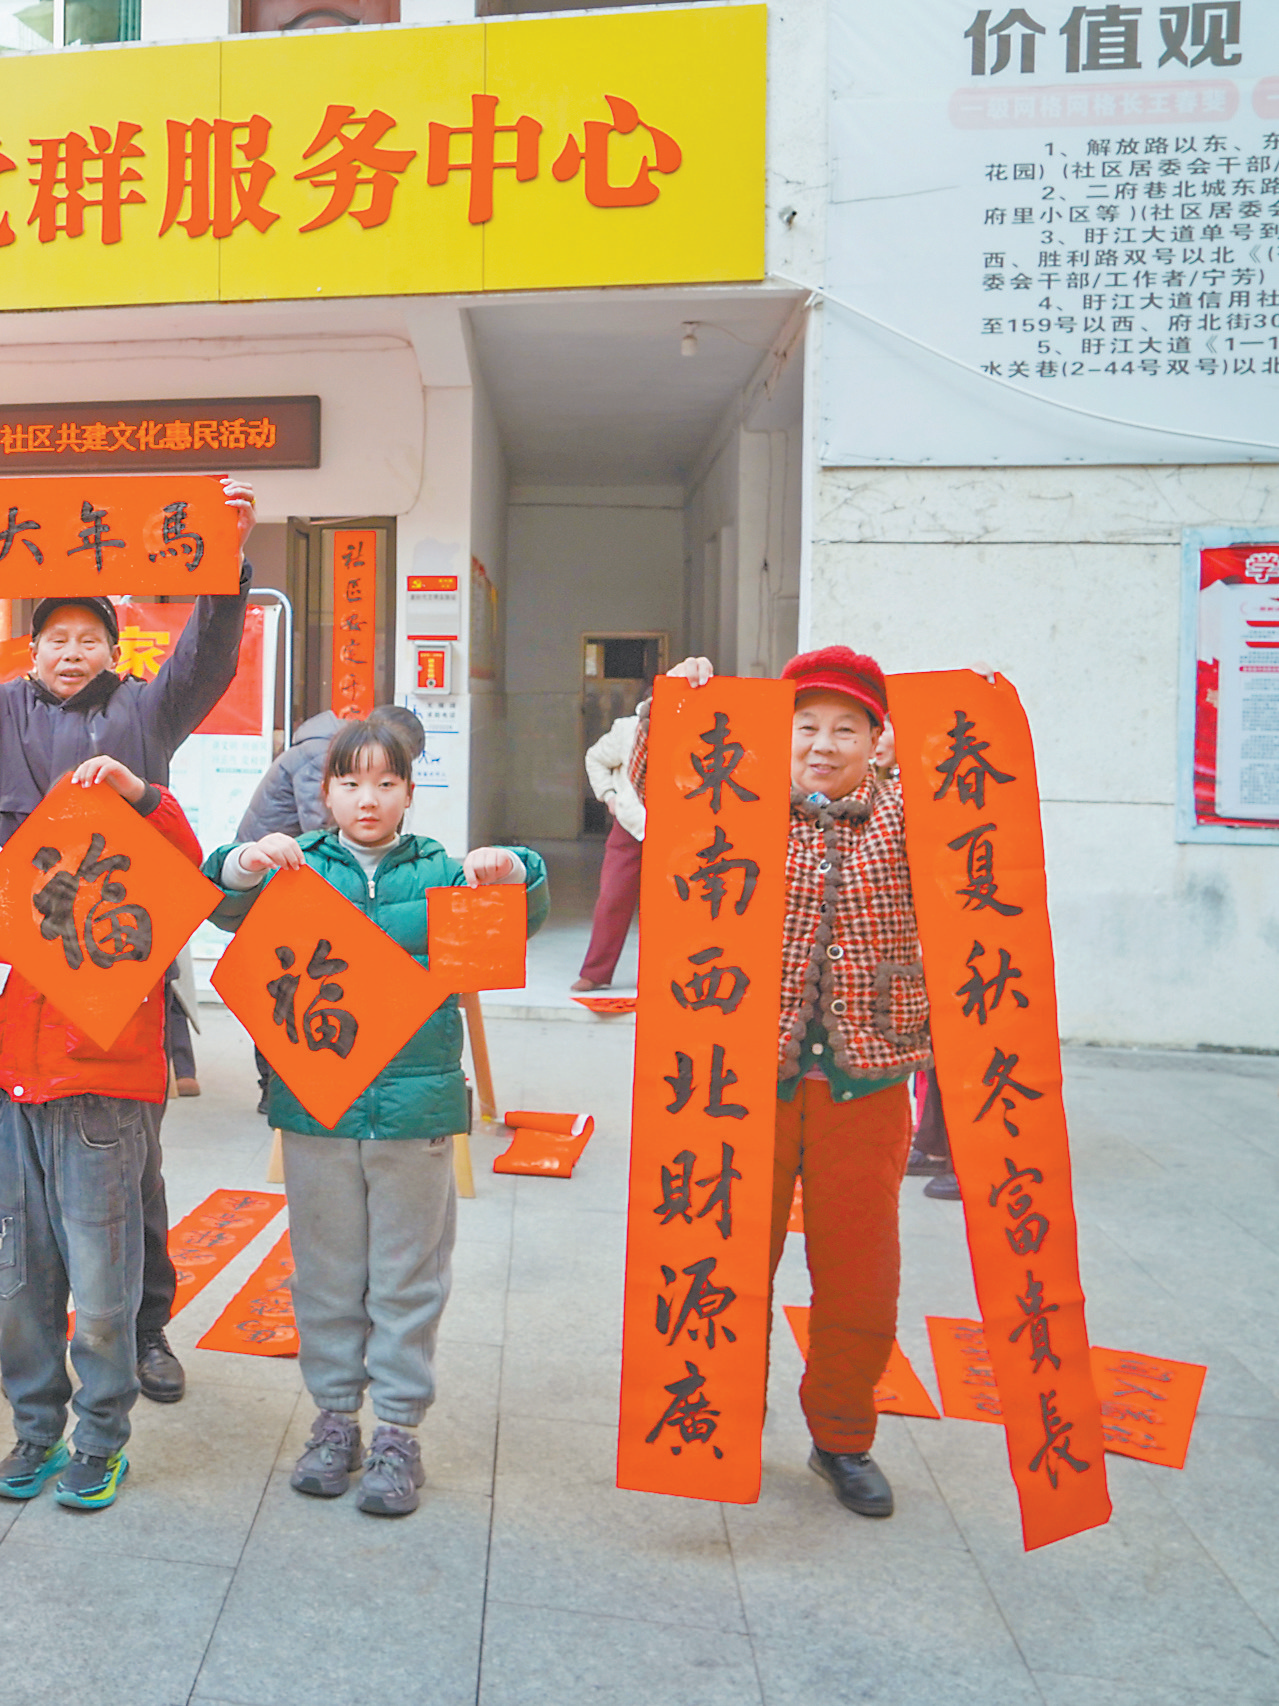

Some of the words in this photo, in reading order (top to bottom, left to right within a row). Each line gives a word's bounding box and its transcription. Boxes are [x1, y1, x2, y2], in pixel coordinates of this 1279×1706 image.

[964, 1, 1243, 76] 价值观
[31, 832, 153, 970] 福
[265, 938, 360, 1060] 福
[644, 711, 761, 1460] 東南西北財源廣
[932, 710, 1091, 1491] 春夏秋冬富貴長
